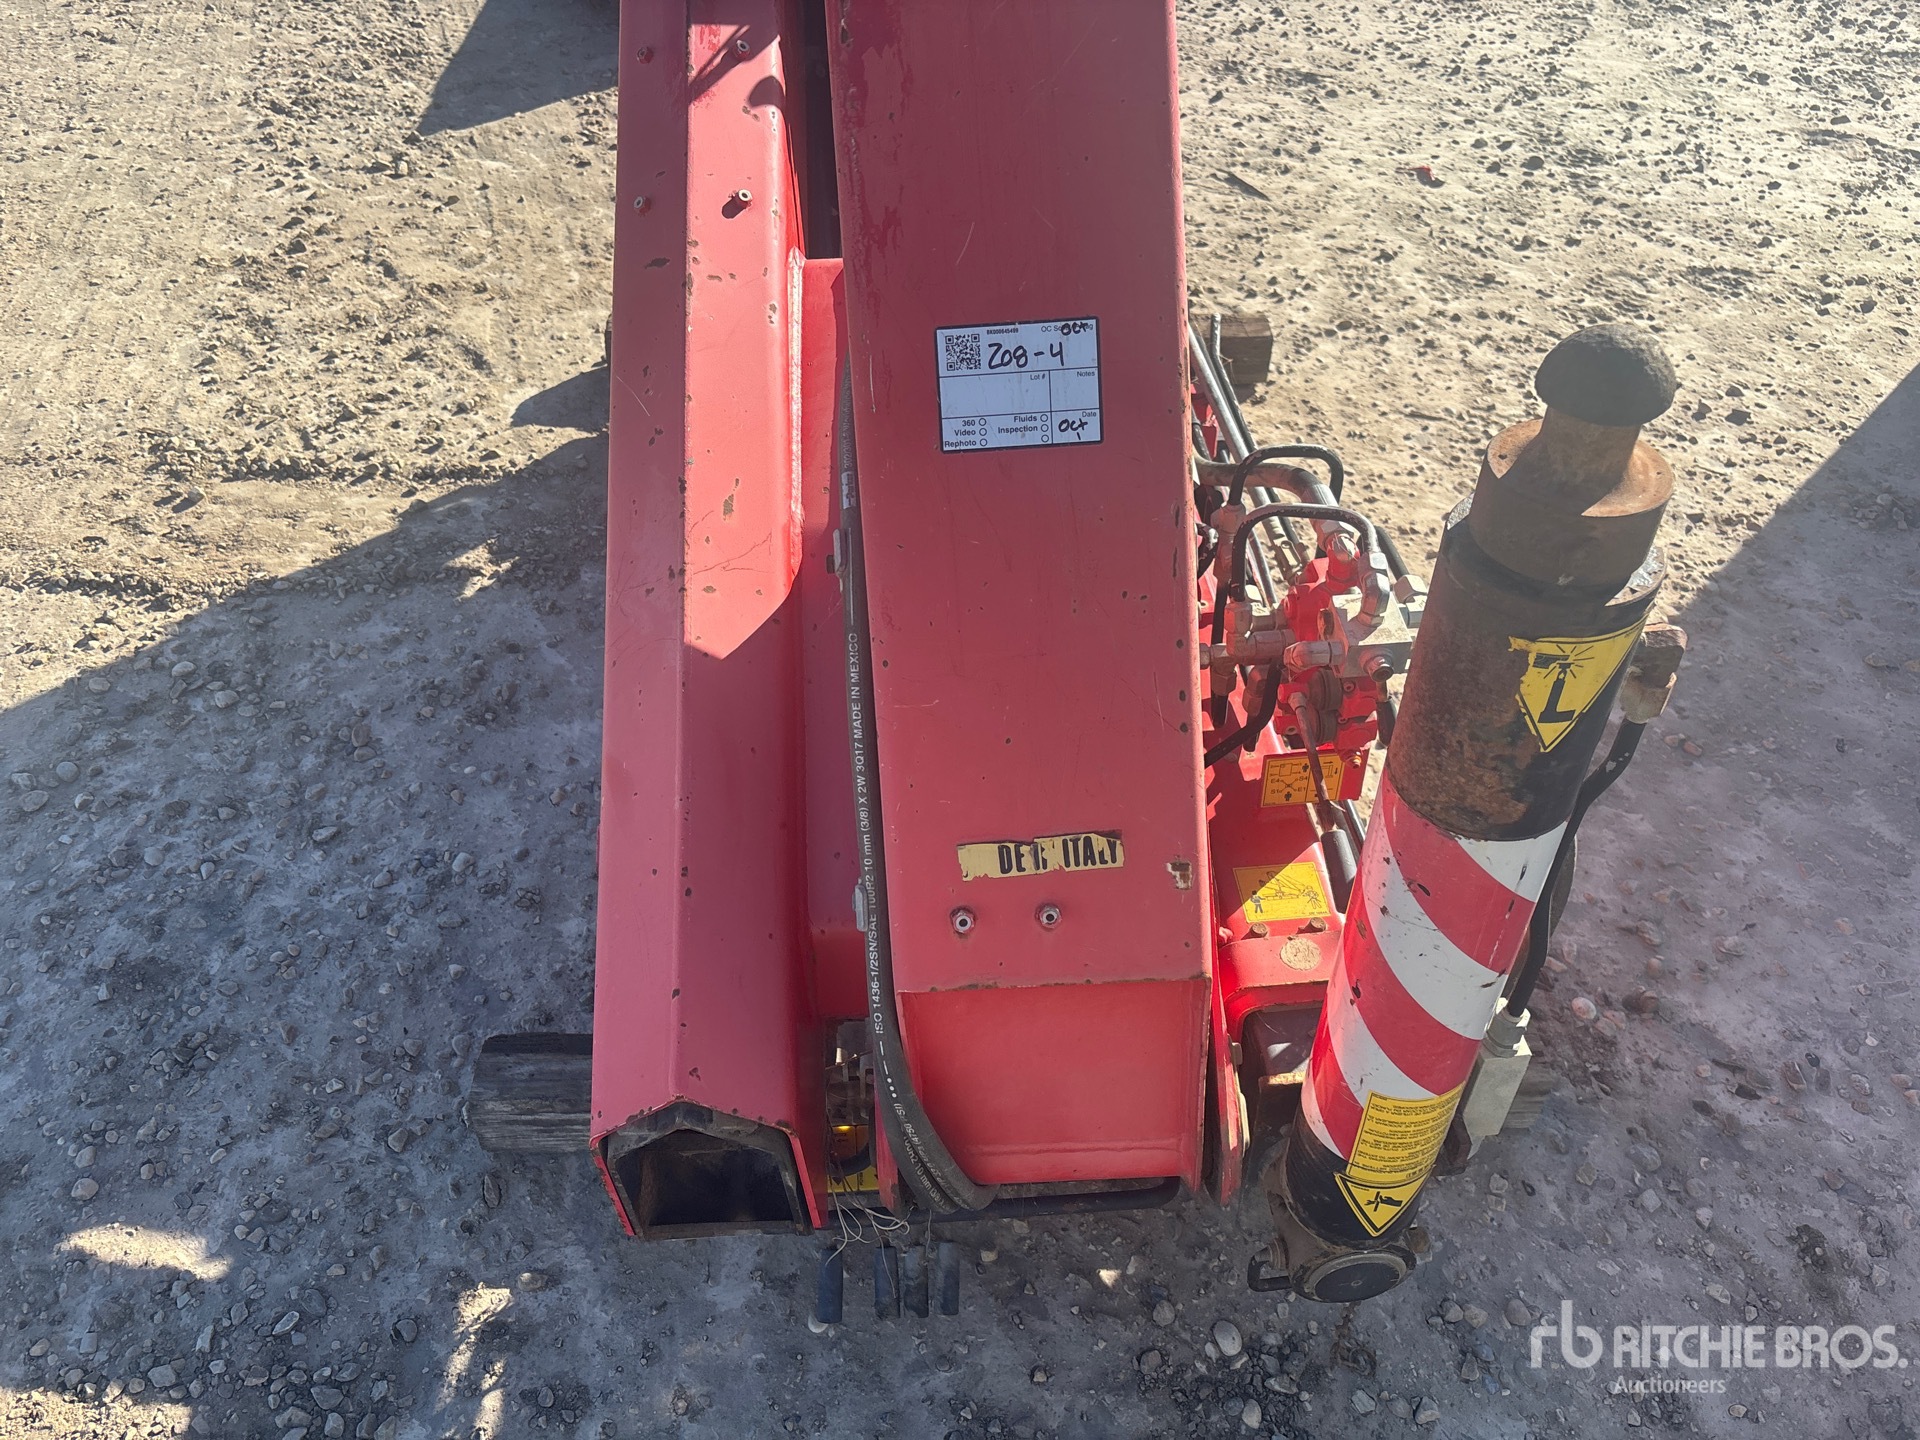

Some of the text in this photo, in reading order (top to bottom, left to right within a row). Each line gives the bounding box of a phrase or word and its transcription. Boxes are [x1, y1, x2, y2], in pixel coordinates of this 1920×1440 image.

[1013, 415, 1038, 423] Fluids
[997, 425, 1038, 434] Inspection
[945, 440, 977, 448] Rephoto
[848, 633, 860, 683] MEXICO
[851, 687, 860, 698] IN
[852, 702, 863, 739] MADE
[855, 742, 865, 772] 3Q17
[856, 775, 867, 793] 2W
[858, 796, 868, 804] X
[859, 807, 871, 831] (3/8)
[863, 834, 872, 855] mm
[864, 858, 873, 871] 10
[874, 1013, 884, 1034] ISO
[920, 1175, 932, 1190] mm
